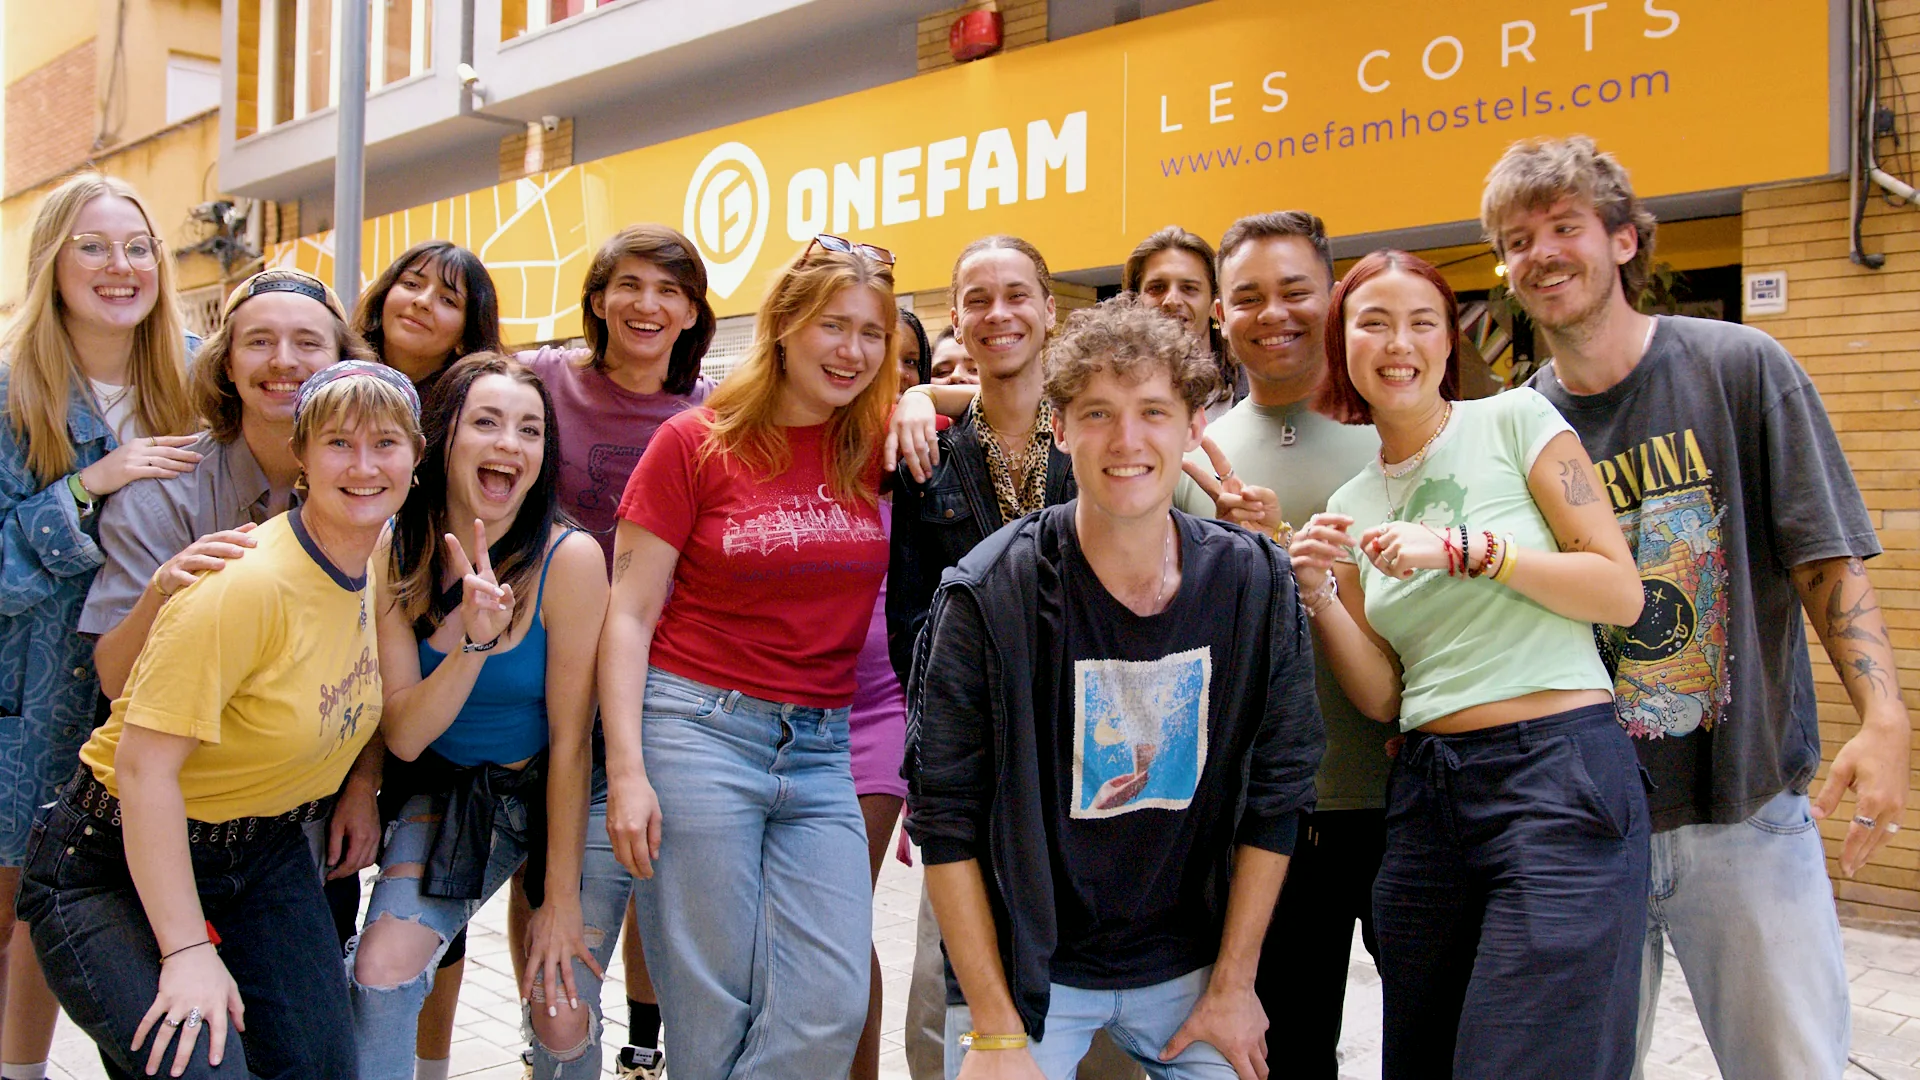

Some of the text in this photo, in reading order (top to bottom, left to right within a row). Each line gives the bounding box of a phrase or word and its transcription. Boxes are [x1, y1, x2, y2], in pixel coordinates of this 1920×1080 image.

[1160, 0, 1680, 133] LES CORTS
[1160, 69, 1670, 177] www.onefamhostels.com
[786, 110, 1088, 242] ONEFAM
